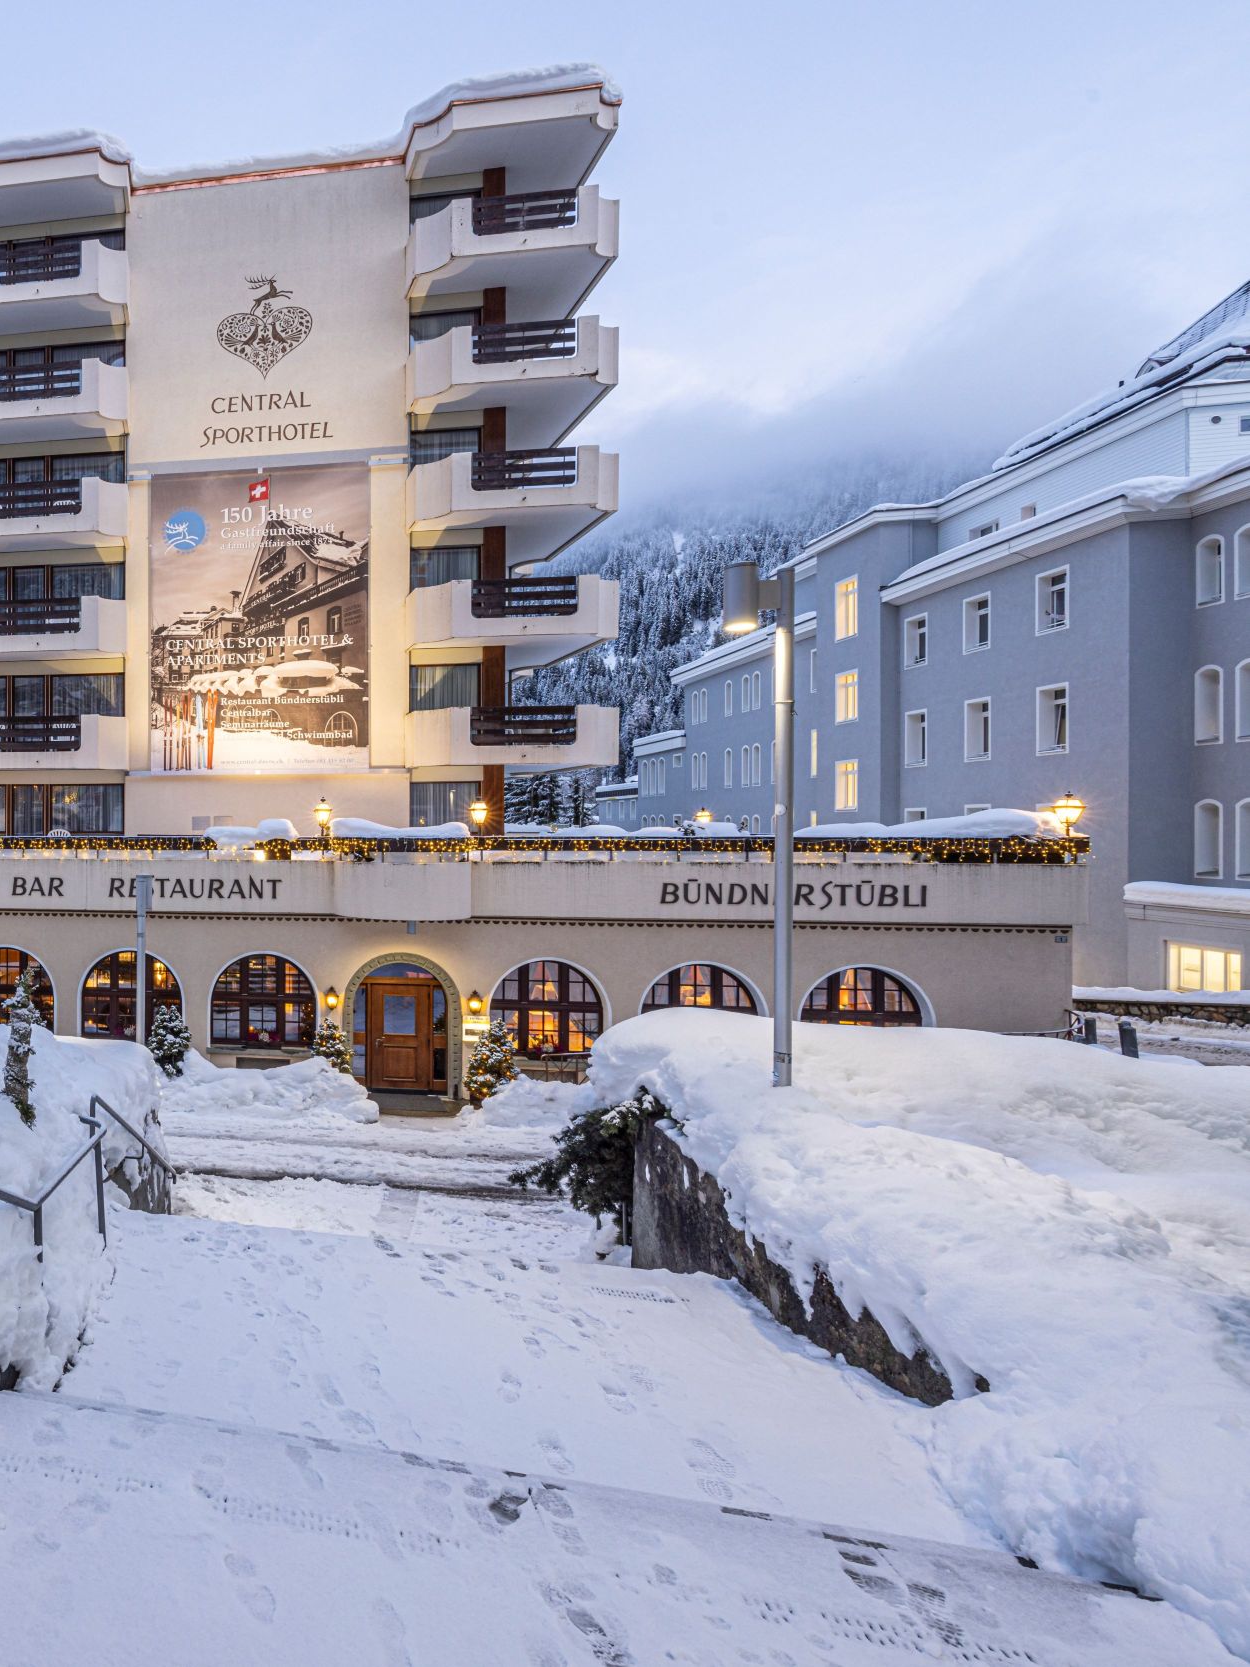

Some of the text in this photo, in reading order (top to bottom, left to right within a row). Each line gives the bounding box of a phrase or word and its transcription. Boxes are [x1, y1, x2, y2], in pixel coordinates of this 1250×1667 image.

[211, 389, 311, 414] CENTRAL
[200, 421, 333, 448] SPORTHOTEL
[220, 504, 313, 526] 150 Jahre
[220, 522, 335, 538] Gastfreundschaft
[287, 538, 310, 546] since
[166, 633, 354, 651] CENTRAL SPORTHOTEL &
[166, 653, 266, 666] APARTMENTS
[220, 694, 344, 706] Restaurant Bündnerstübli
[220, 708, 271, 718] Centralbar
[220, 719, 290, 729] Seminarräume
[287, 729, 353, 739] Schwimmbad
[11, 876, 65, 898] BAR
[108, 874, 282, 900] RETAURANT
